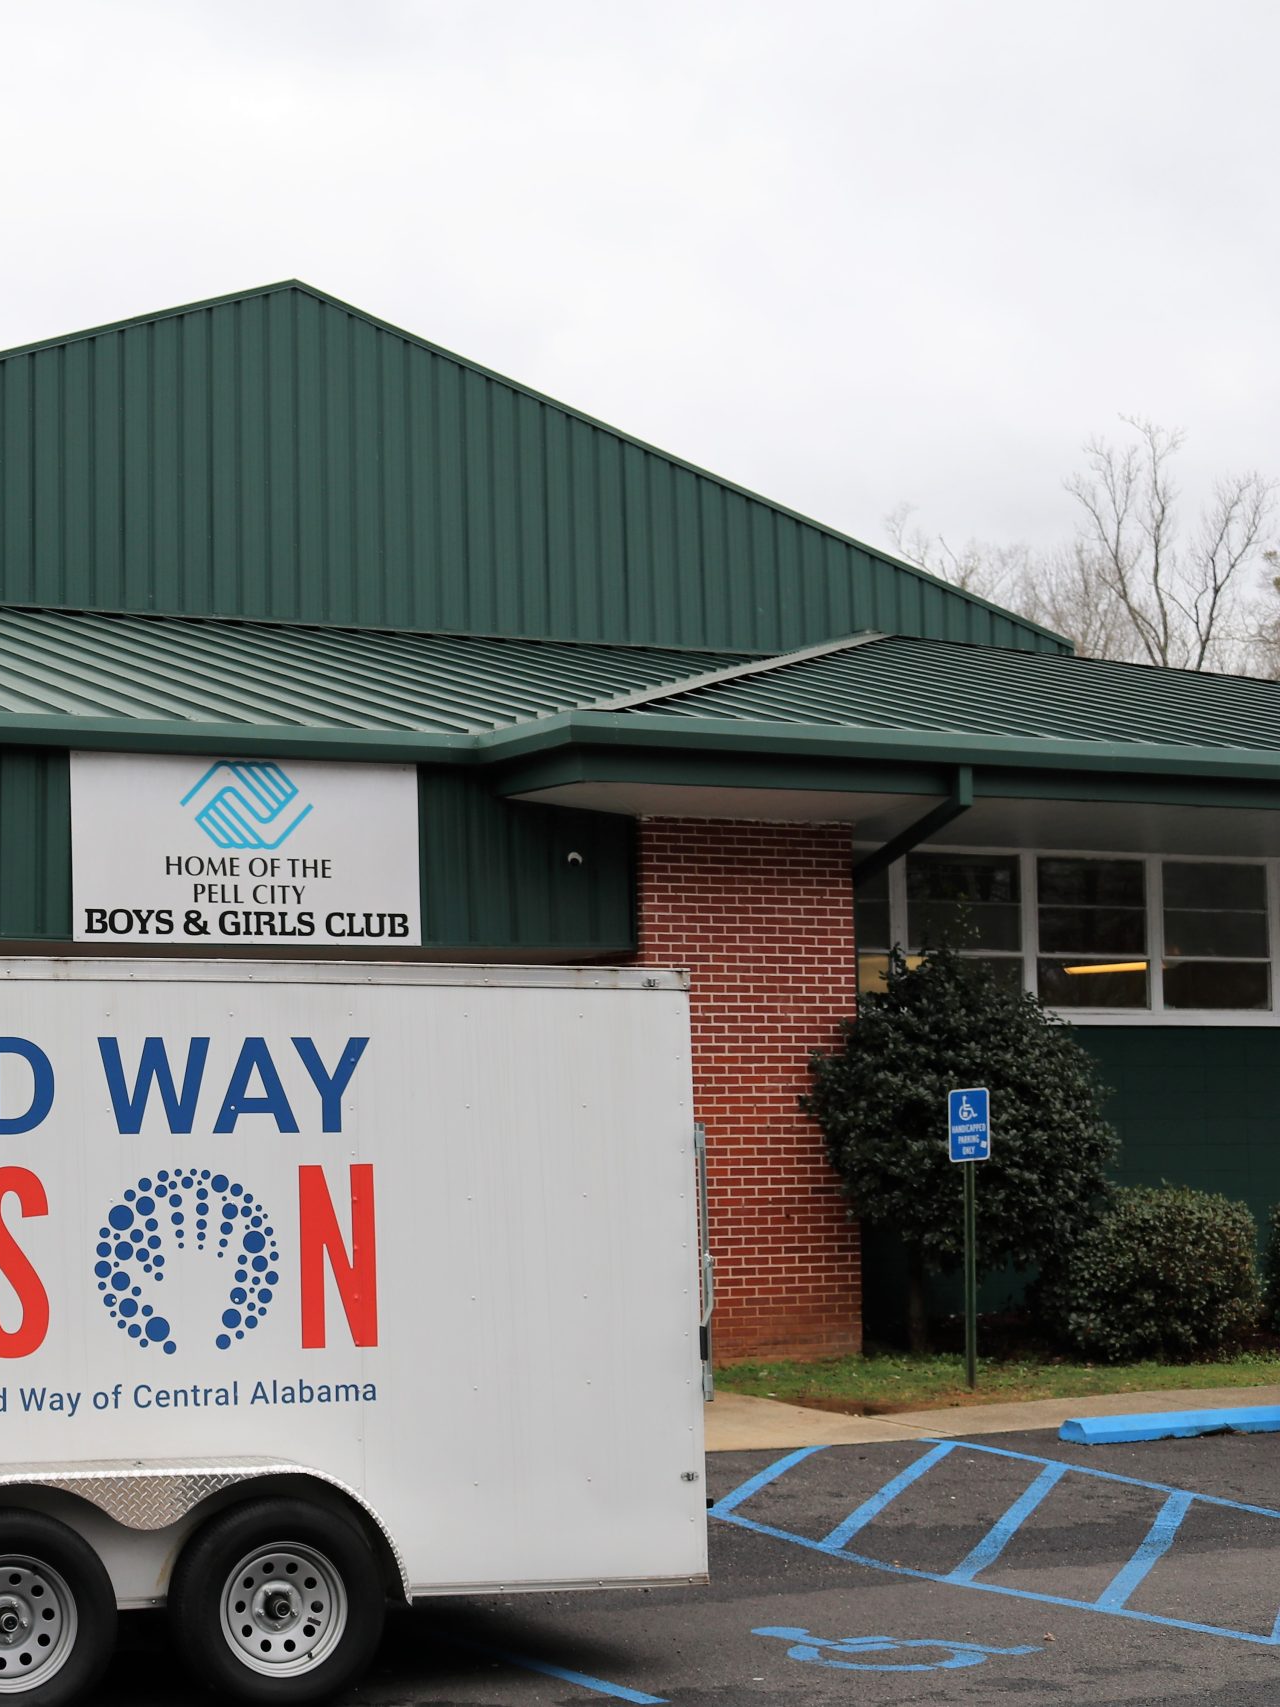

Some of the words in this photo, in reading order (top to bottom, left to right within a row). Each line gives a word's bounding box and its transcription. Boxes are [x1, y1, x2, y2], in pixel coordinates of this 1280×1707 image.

[166, 856, 240, 877] HOME
[249, 857, 281, 877] OF
[287, 859, 332, 878] THE
[194, 884, 245, 904] PELL
[253, 885, 305, 905] CITY
[85, 909, 174, 935] BOYS
[183, 910, 211, 935] &
[219, 911, 316, 937] GIRLS
[325, 912, 410, 938] CLUB
[97, 1037, 370, 1135] WAY
[951, 1123, 986, 1133] HANDICAPPED
[958, 1134, 980, 1145] PARKING
[962, 1146, 975, 1155] ONLY
[20, 1387, 81, 1417] Way
[92, 1384, 122, 1410] of
[133, 1382, 239, 1408] Central
[250, 1380, 378, 1406] Alabama
